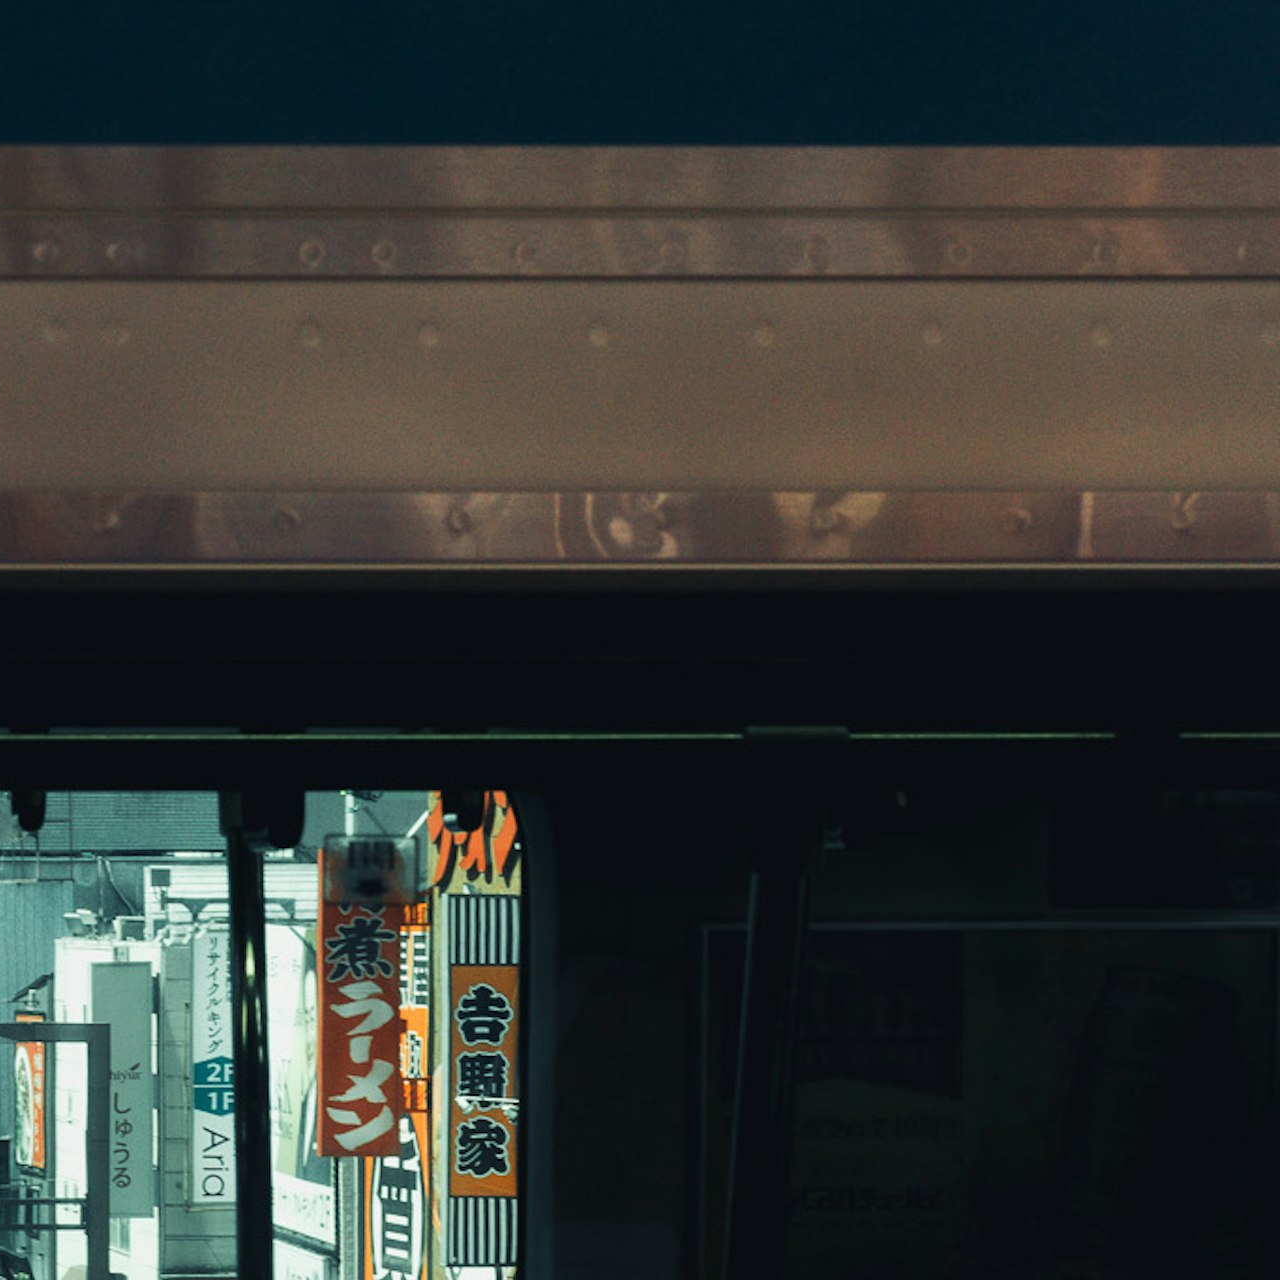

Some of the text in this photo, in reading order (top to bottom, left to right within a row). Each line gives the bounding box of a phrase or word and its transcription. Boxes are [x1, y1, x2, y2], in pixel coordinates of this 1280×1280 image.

[205, 936, 222, 1054] リサイクルキング
[326, 903, 396, 1151] 煮ラーメン
[112, 1092, 133, 1188] しゅうる
[202, 1126, 230, 1197] Aria
